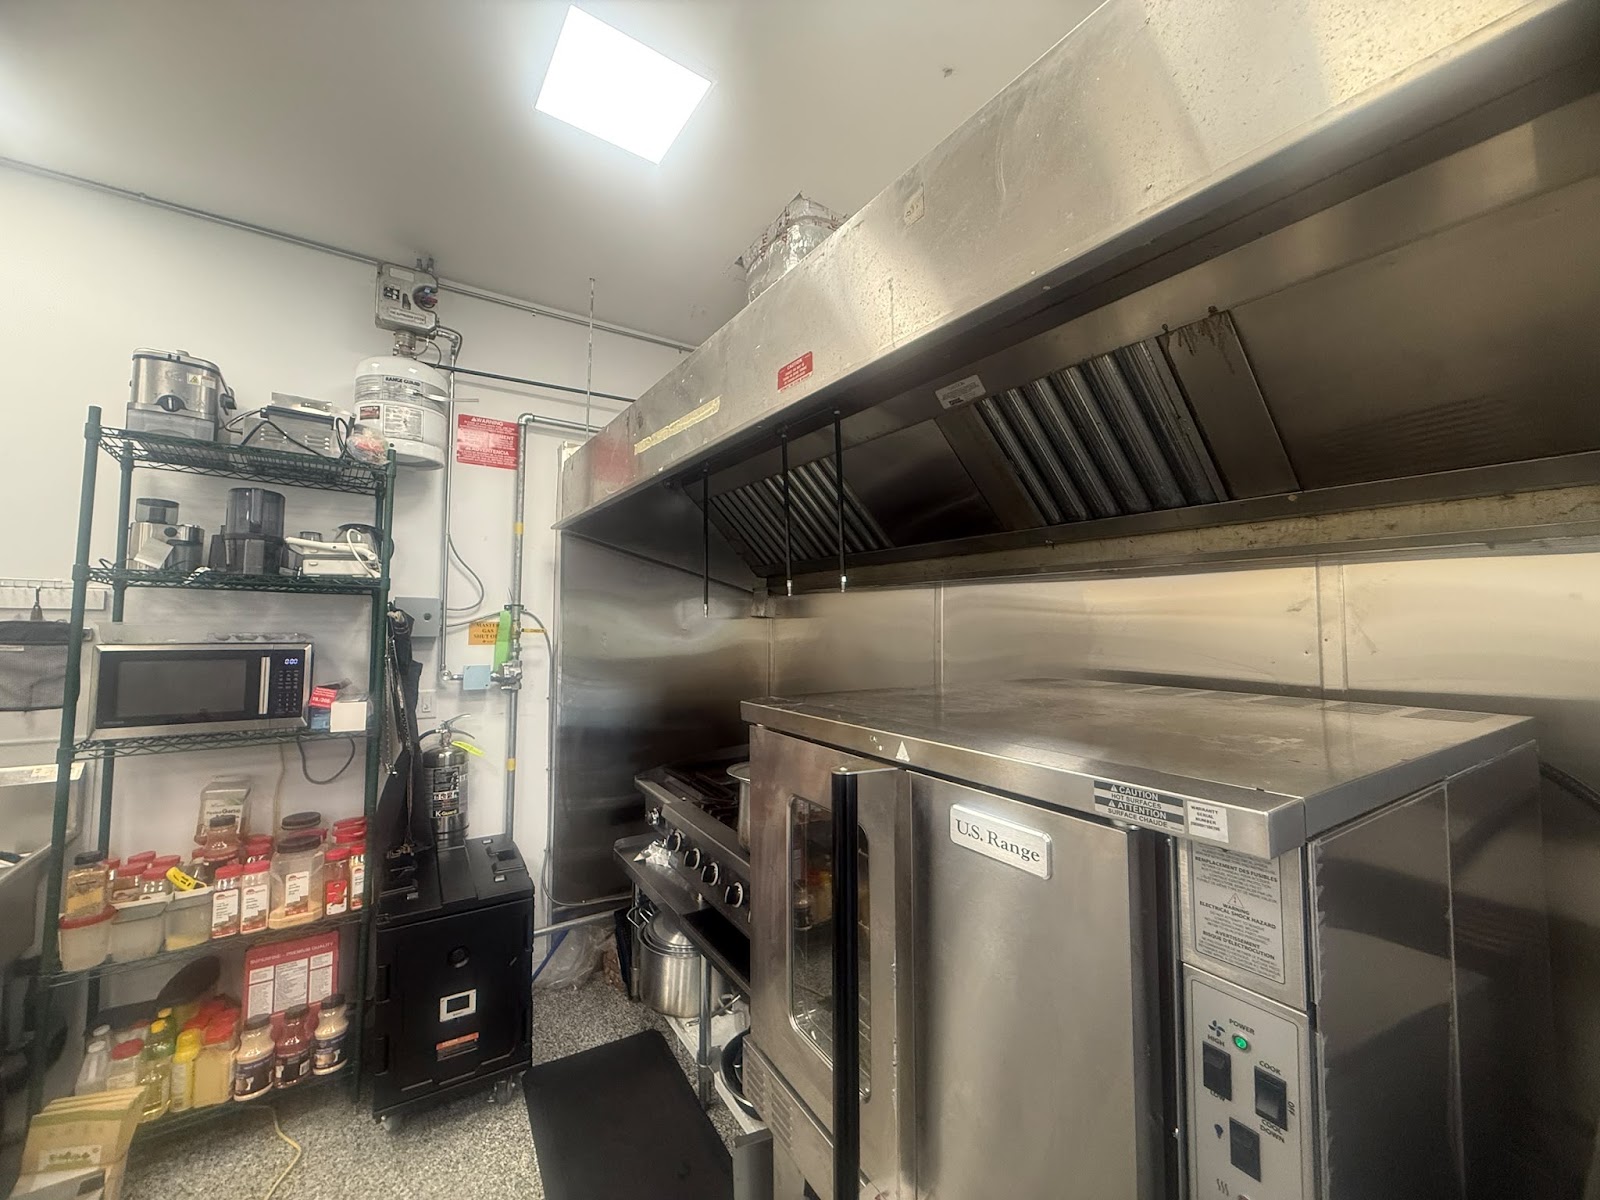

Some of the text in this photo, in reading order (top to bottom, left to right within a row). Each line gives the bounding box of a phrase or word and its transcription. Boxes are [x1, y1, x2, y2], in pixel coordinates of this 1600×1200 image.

[476, 418, 504, 426] WARNING
[1111, 793, 1162, 810] HOT SURFACES
[1119, 786, 1159, 802] CAUTION
[1108, 808, 1168, 828] SURFACE CHAUDE
[1117, 801, 1167, 820] ATTENTION
[956, 818, 1041, 863] U.S. Range
[1195, 856, 1238, 872] REMPLACEMENT
[1250, 871, 1278, 883] FUSIBLES
[1200, 900, 1277, 930] ELECTRICAL SHOCK HAZARD
[1222, 903, 1250, 916] WARNING
[1202, 930, 1222, 942] RISQUE
[1215, 930, 1261, 950] AVERTISSEMENT
[286, 947, 311, 957] PREMIUM
[312, 942, 334, 950] QUALITY
[1228, 1018, 1256, 1036] POWER
[1207, 1034, 1226, 1048] HIGH
[1259, 1060, 1282, 1076] COOK
[1210, 1090, 1226, 1102] LOW
[1288, 1101, 1296, 1116] OFF
[1259, 1125, 1285, 1144] DOWN
[1261, 1119, 1283, 1136] COOL
